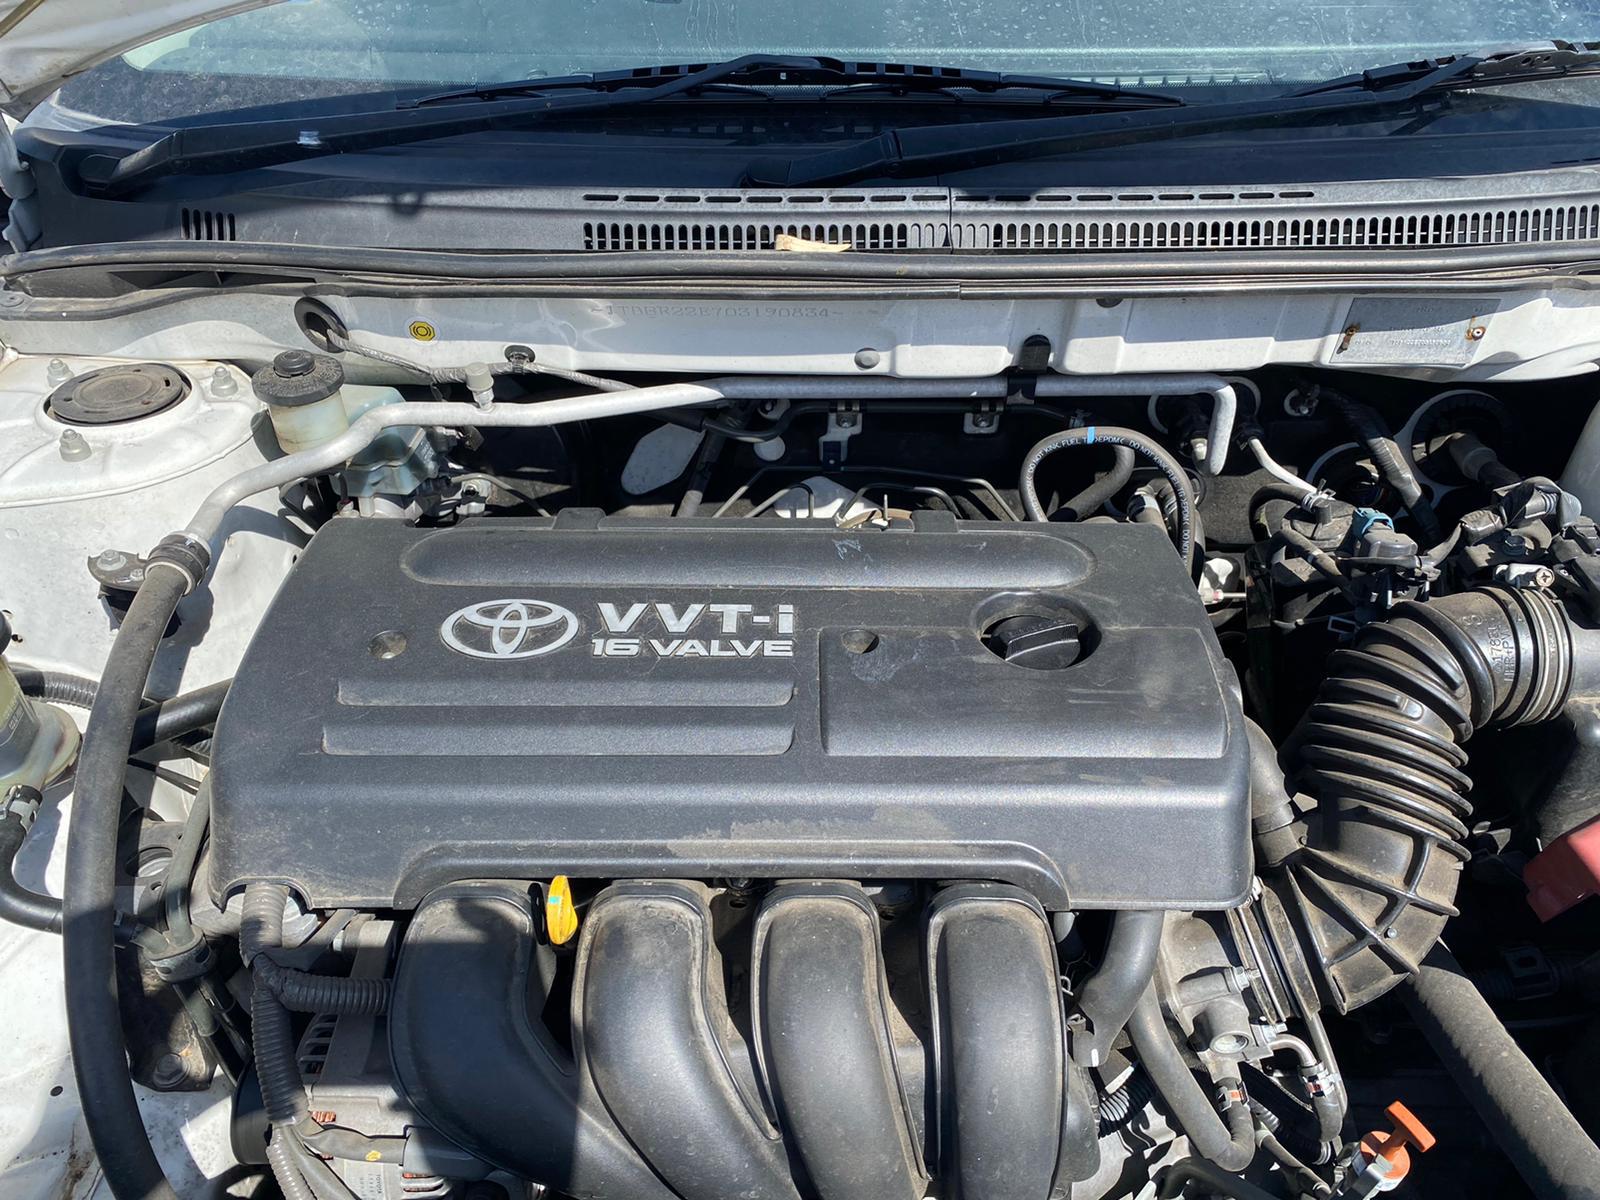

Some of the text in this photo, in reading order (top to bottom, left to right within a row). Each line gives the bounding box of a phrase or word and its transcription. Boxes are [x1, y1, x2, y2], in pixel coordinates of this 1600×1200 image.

[1061, 437, 1081, 447] FUEL
[1128, 440, 1140, 449] DO
[1139, 445, 1154, 457] NOT
[1166, 468, 1181, 487] FUEL
[1182, 529, 1190, 539] DO
[1182, 540, 1190, 553] NOT
[597, 603, 794, 633] VVT-i
[592, 639, 793, 657] 16 VALVE
